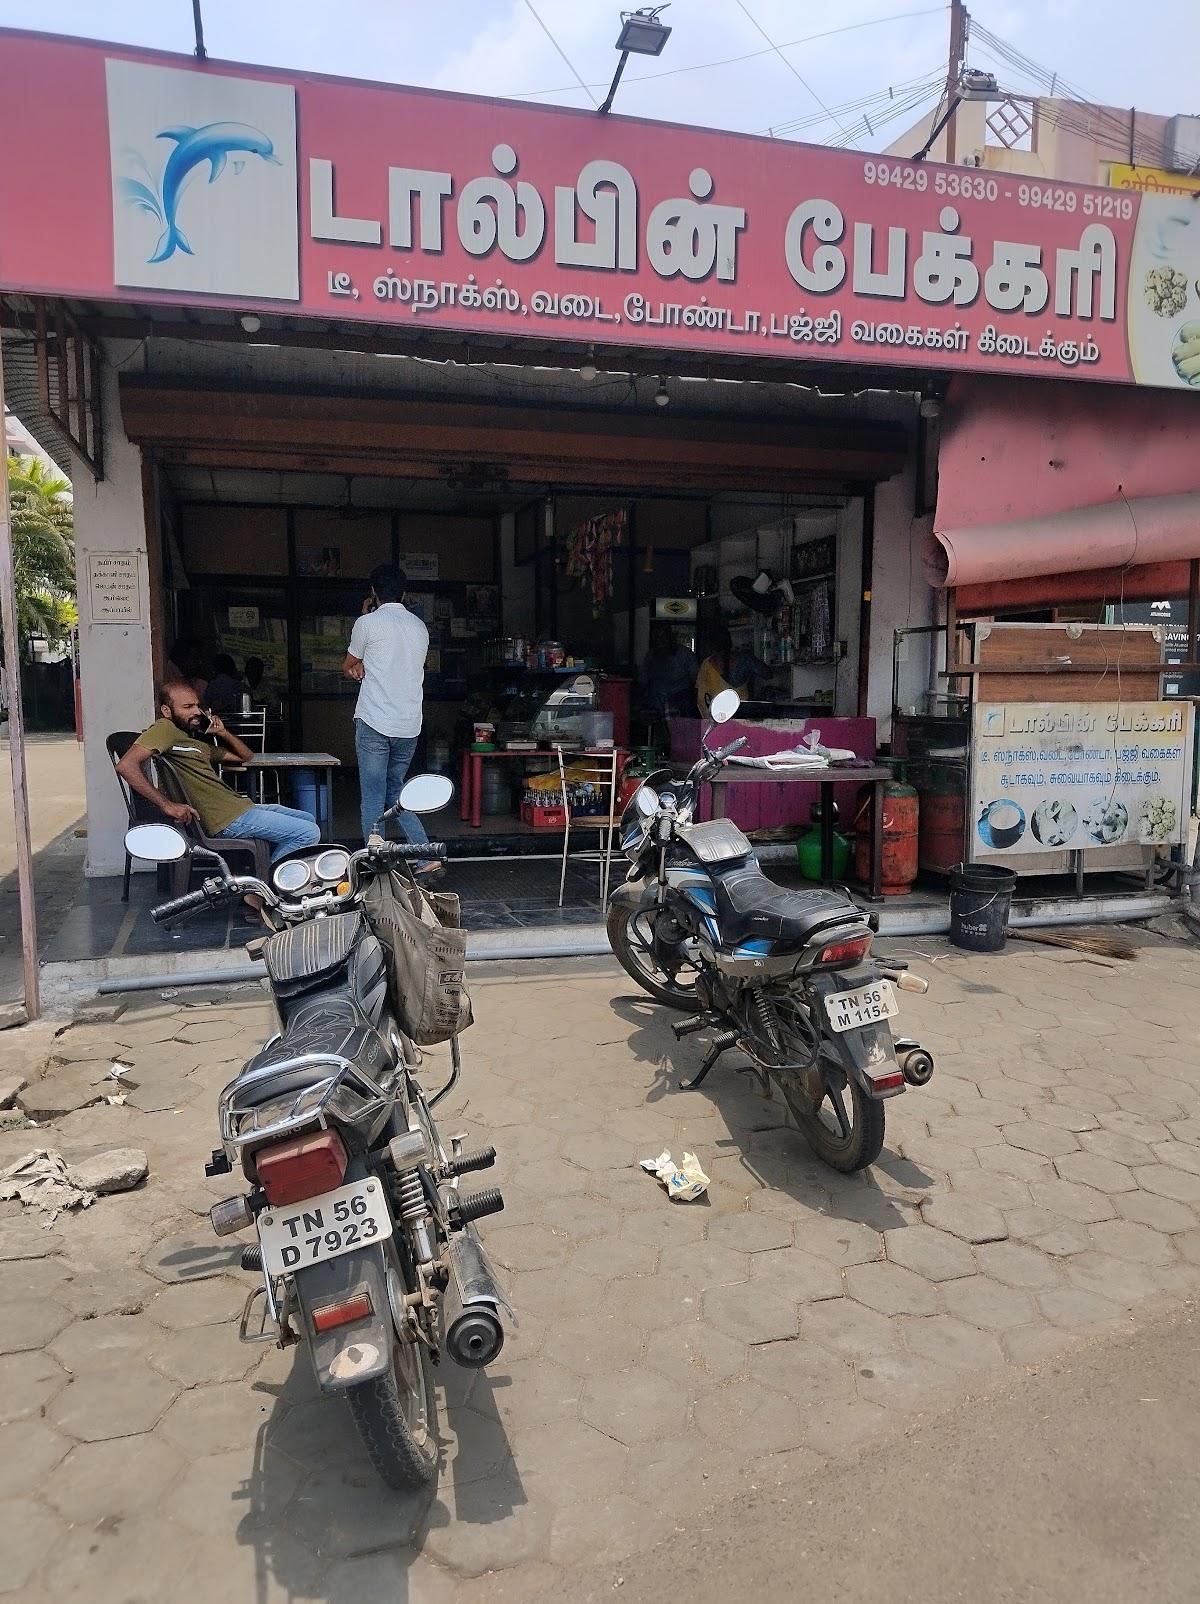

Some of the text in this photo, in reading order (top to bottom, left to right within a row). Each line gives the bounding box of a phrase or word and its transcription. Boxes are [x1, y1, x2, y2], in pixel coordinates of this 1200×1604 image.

[863, 161, 928, 192] 99429
[934, 172, 998, 202] 53630
[1018, 184, 1077, 213] 99429
[1082, 193, 1133, 220] 51219
[309, 143, 1117, 320] டால்பின் பேக்கரி
[850, 321, 970, 350] வகைகள்
[977, 324, 1099, 365] கிடைக்கும்
[1009, 709, 1183, 734] டால்பின் பேக்கரி
[1141, 745, 1182, 760] வகைகள்
[837, 991, 881, 1011] TN 56
[837, 1002, 890, 1027] M 1154
[282, 1195, 368, 1238] TN 56
[280, 1217, 379, 1268] D 7923
